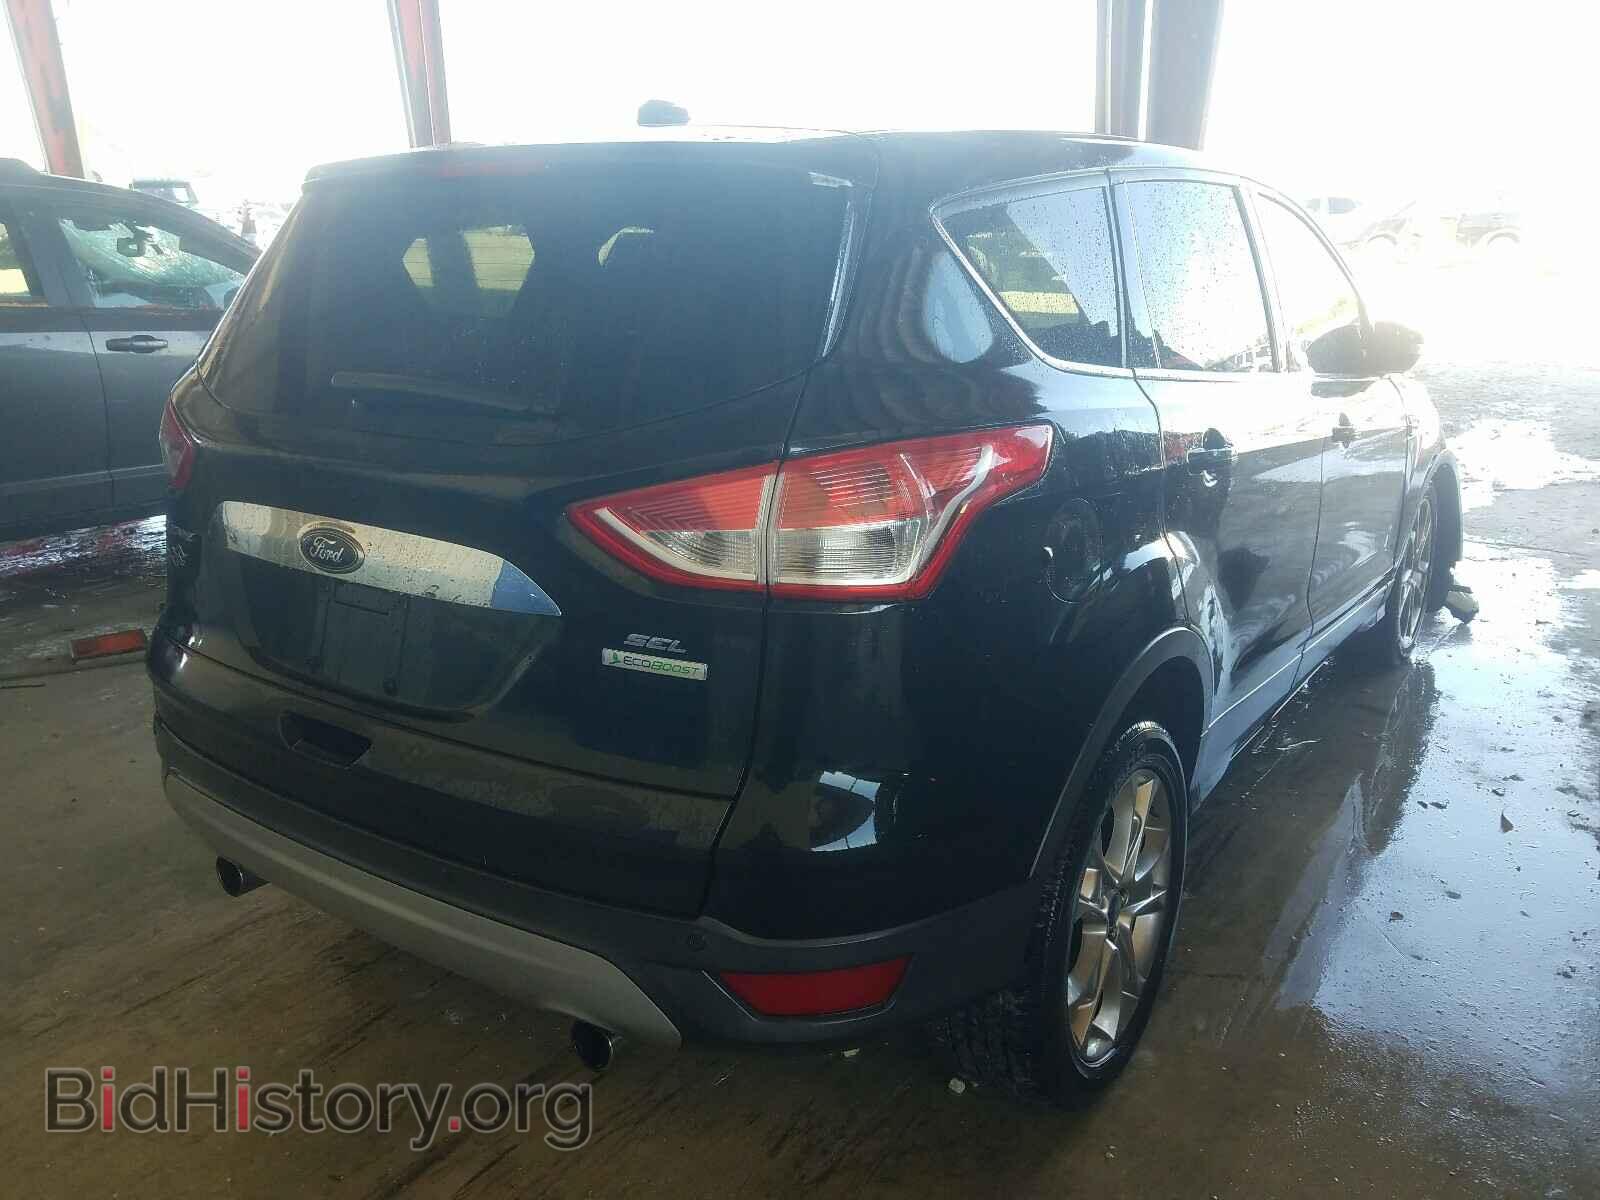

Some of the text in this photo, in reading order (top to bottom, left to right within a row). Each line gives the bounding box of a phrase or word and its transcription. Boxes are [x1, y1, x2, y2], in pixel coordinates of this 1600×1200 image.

[309, 534, 344, 562] Ford
[624, 633, 687, 653] SEL
[623, 655, 700, 677] ECOBOOST
